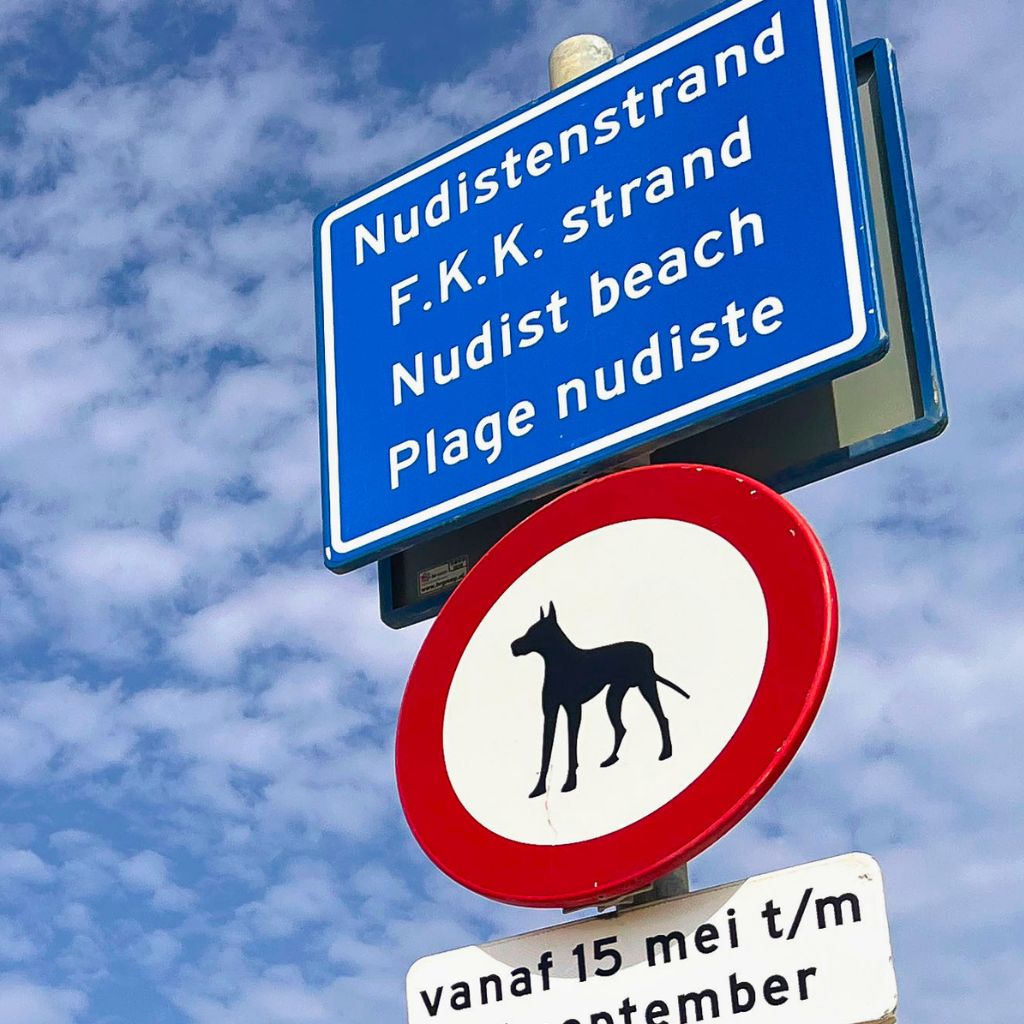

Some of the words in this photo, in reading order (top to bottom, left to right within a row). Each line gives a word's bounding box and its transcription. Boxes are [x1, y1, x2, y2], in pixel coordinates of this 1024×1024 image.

[355, 11, 785, 266] Nudistenstrand
[391, 223, 544, 326] F.K.K.
[562, 115, 752, 243] strand
[388, 400, 536, 490] Plage
[557, 296, 784, 420] nudiste
[392, 290, 569, 406] Nudist
[590, 207, 764, 318] beach
[419, 951, 554, 1017] vanaf
[571, 935, 622, 983] 15
[645, 909, 739, 967] mei
[761, 887, 862, 941] t/m
